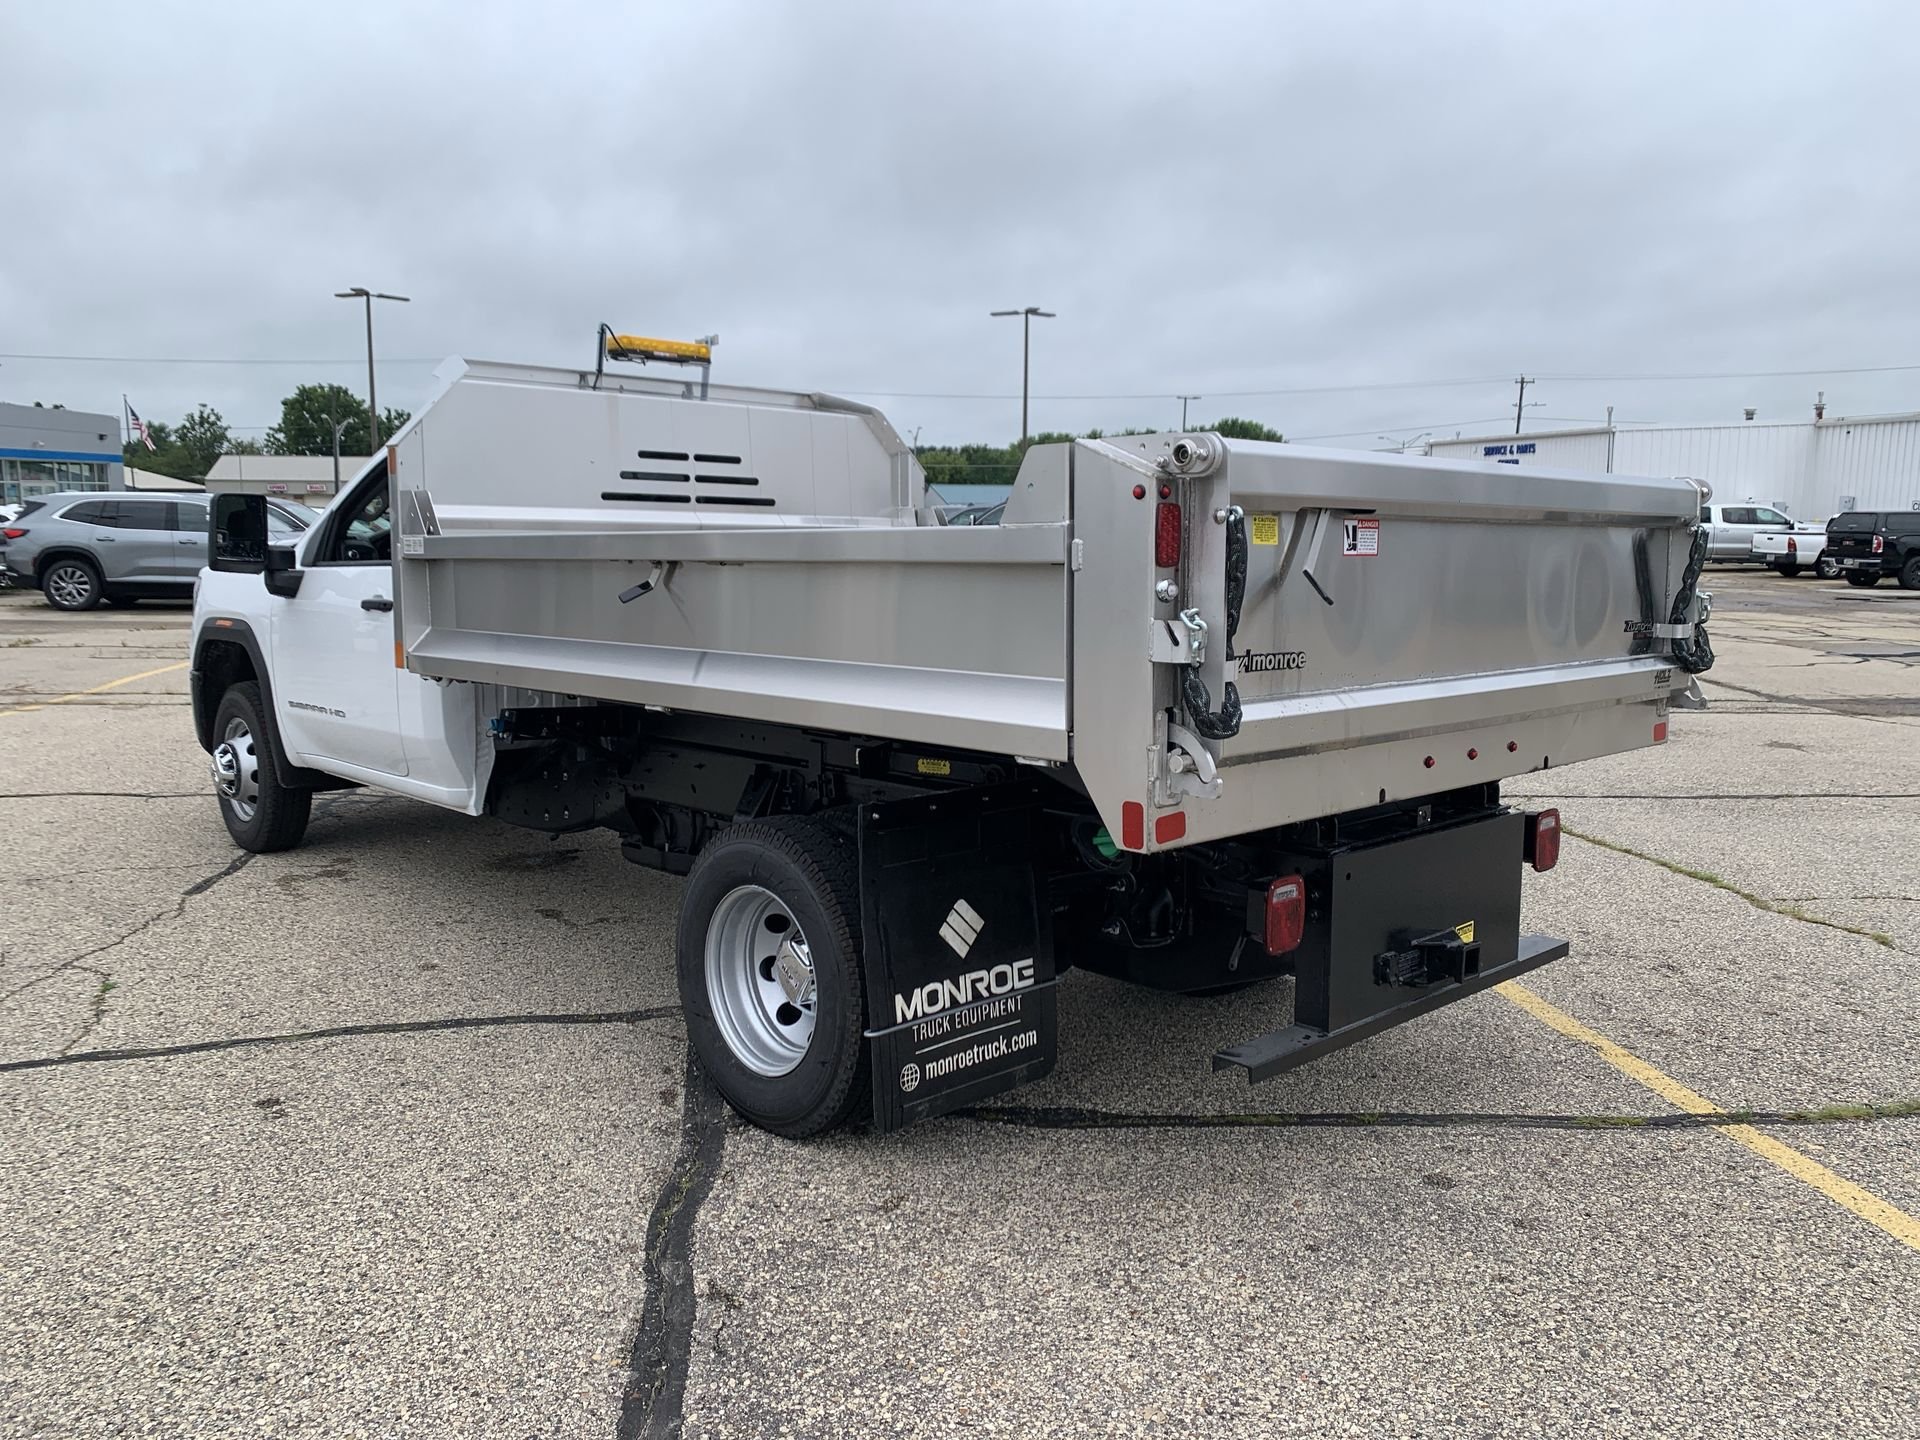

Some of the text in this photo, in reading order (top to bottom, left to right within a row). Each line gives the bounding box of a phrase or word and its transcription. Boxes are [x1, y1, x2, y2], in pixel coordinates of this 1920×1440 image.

[1484, 443, 1536, 456] SERVICE & PARTS
[1362, 520, 1378, 529] DANGER
[1251, 651, 1307, 672] monroe
[287, 700, 346, 718] SIERRA HD
[895, 958, 1034, 1024] MONROE
[912, 995, 1022, 1042] TRUCK EQUIPMENT
[925, 1030, 1037, 1080] monroetruck.com
